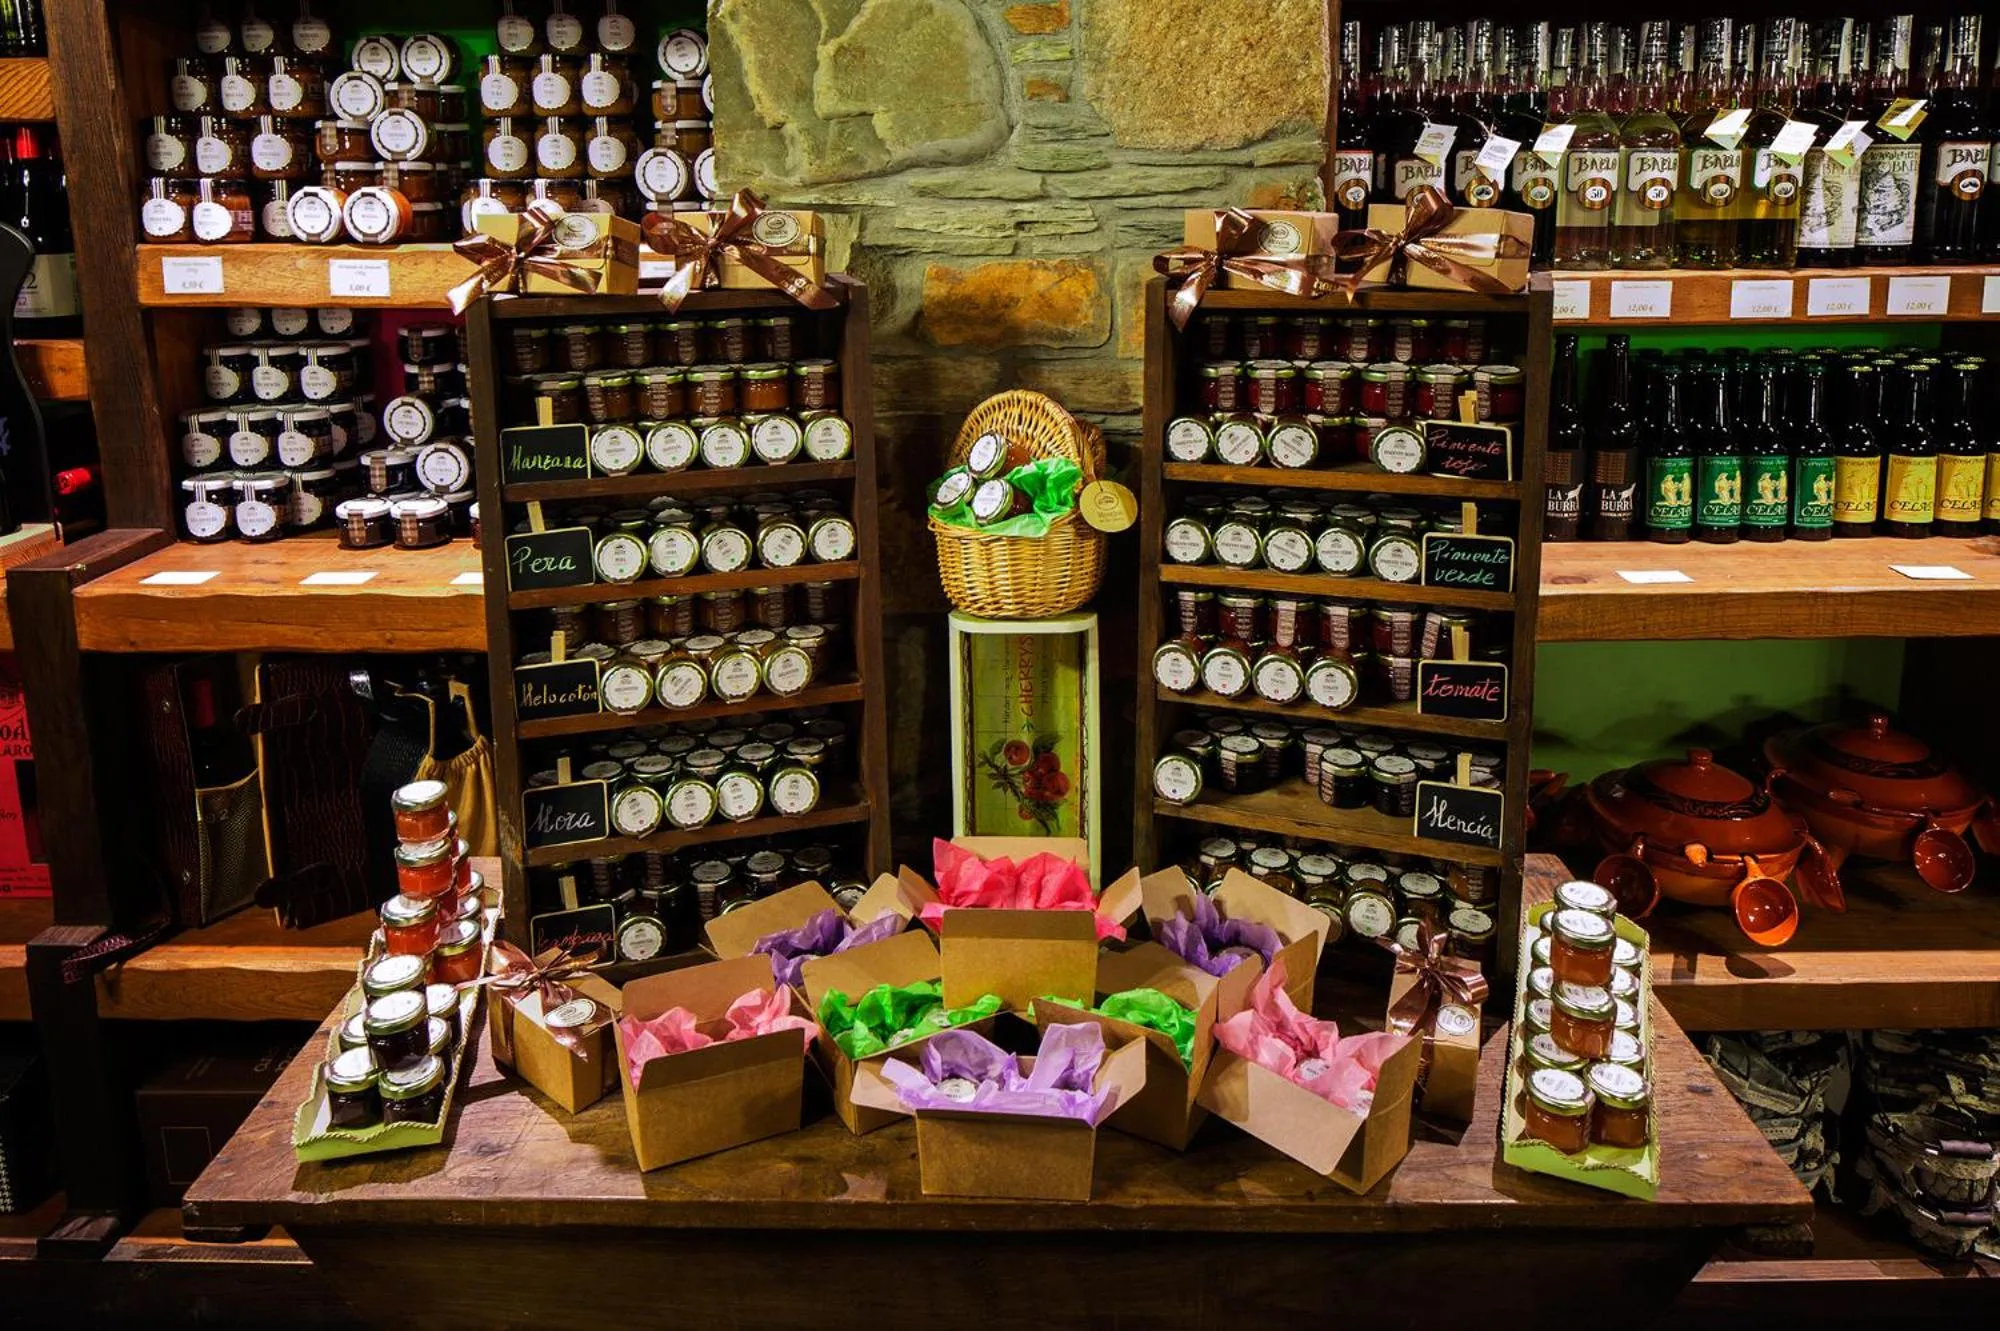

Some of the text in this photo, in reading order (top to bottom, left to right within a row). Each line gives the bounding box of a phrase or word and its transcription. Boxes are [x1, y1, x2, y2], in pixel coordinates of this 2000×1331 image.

[1428, 428, 1504, 456] Pimiento
[1440, 453, 1488, 475] rojo
[1549, 488, 1562, 500] LA
[1601, 488, 1616, 500] LA
[512, 545, 577, 574] Pera
[1428, 539, 1510, 565] Pimiento
[1435, 566, 1495, 586] verde
[1019, 635, 1034, 717] CHERRYS
[1423, 673, 1501, 702] tomate
[528, 801, 597, 833] Mora
